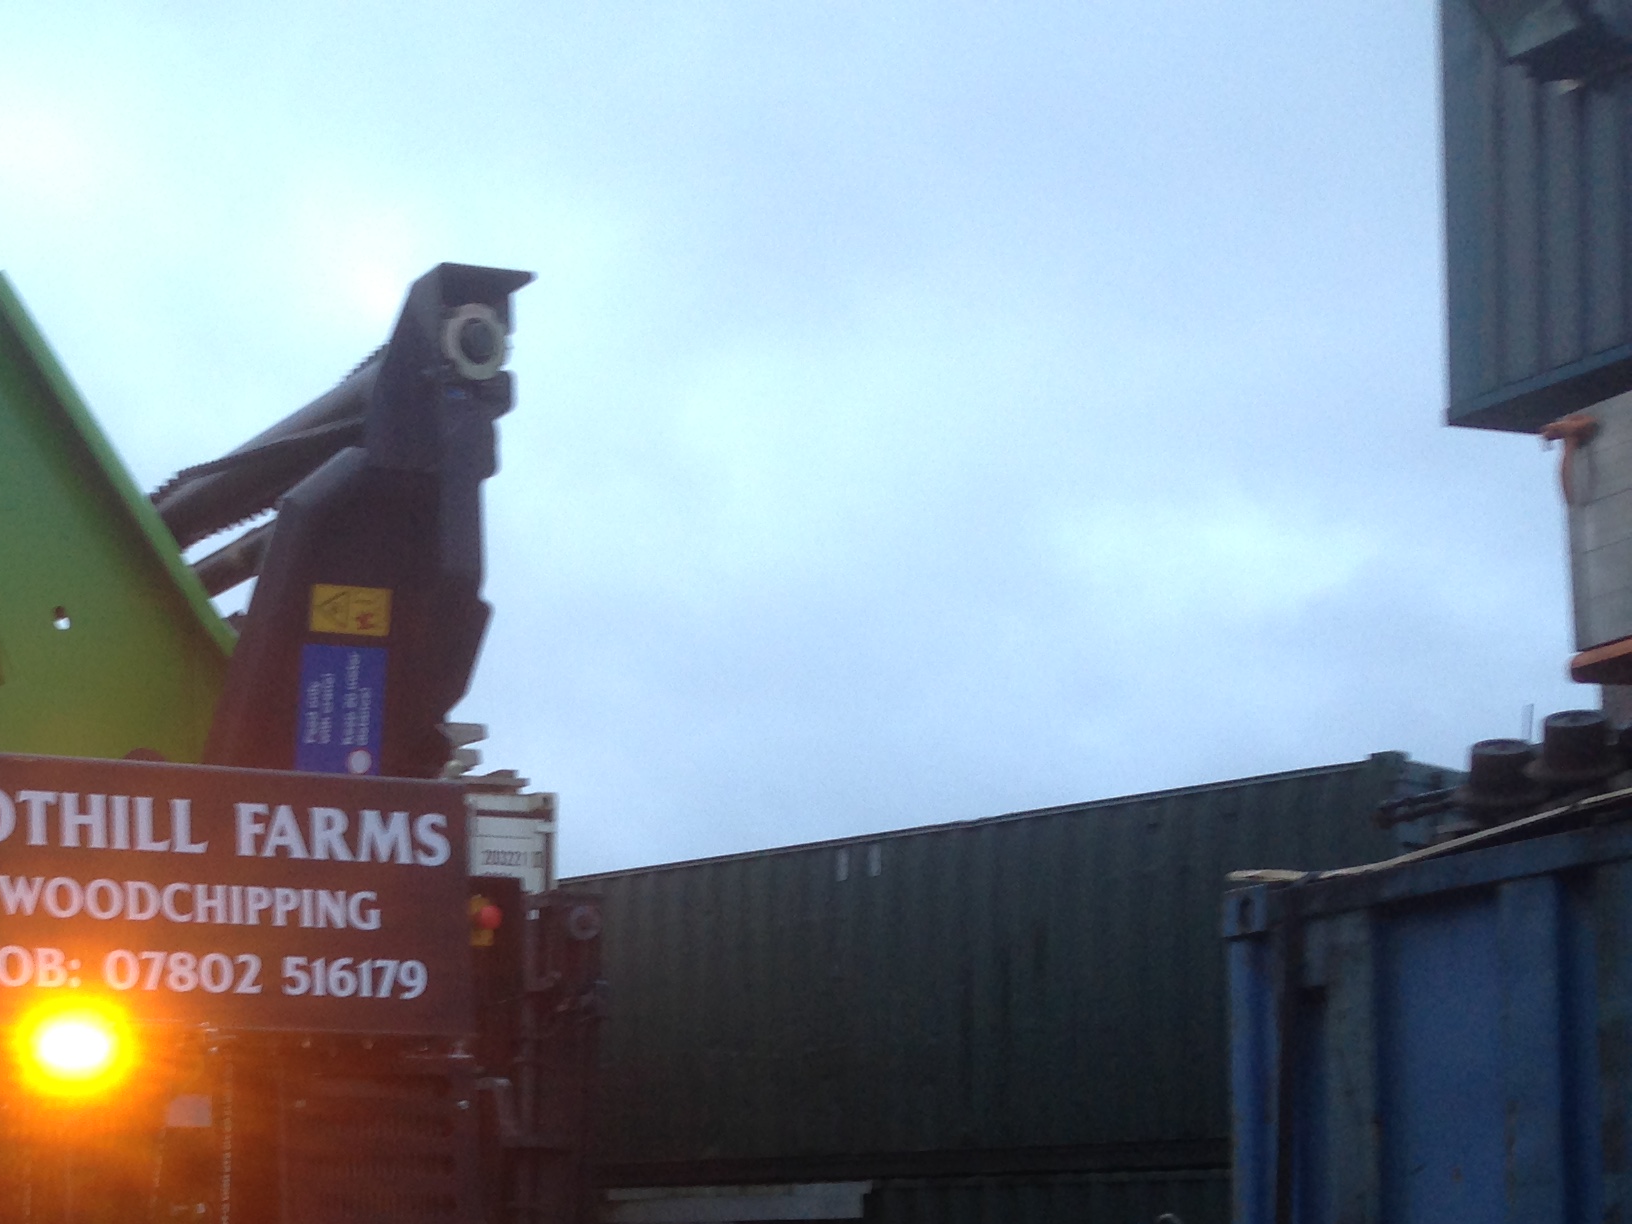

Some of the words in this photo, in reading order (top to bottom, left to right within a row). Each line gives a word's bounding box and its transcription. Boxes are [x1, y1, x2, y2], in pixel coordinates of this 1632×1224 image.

[234, 802, 452, 867] FARMS
[104, 949, 263, 994] 07802
[282, 956, 429, 1000] 516179
